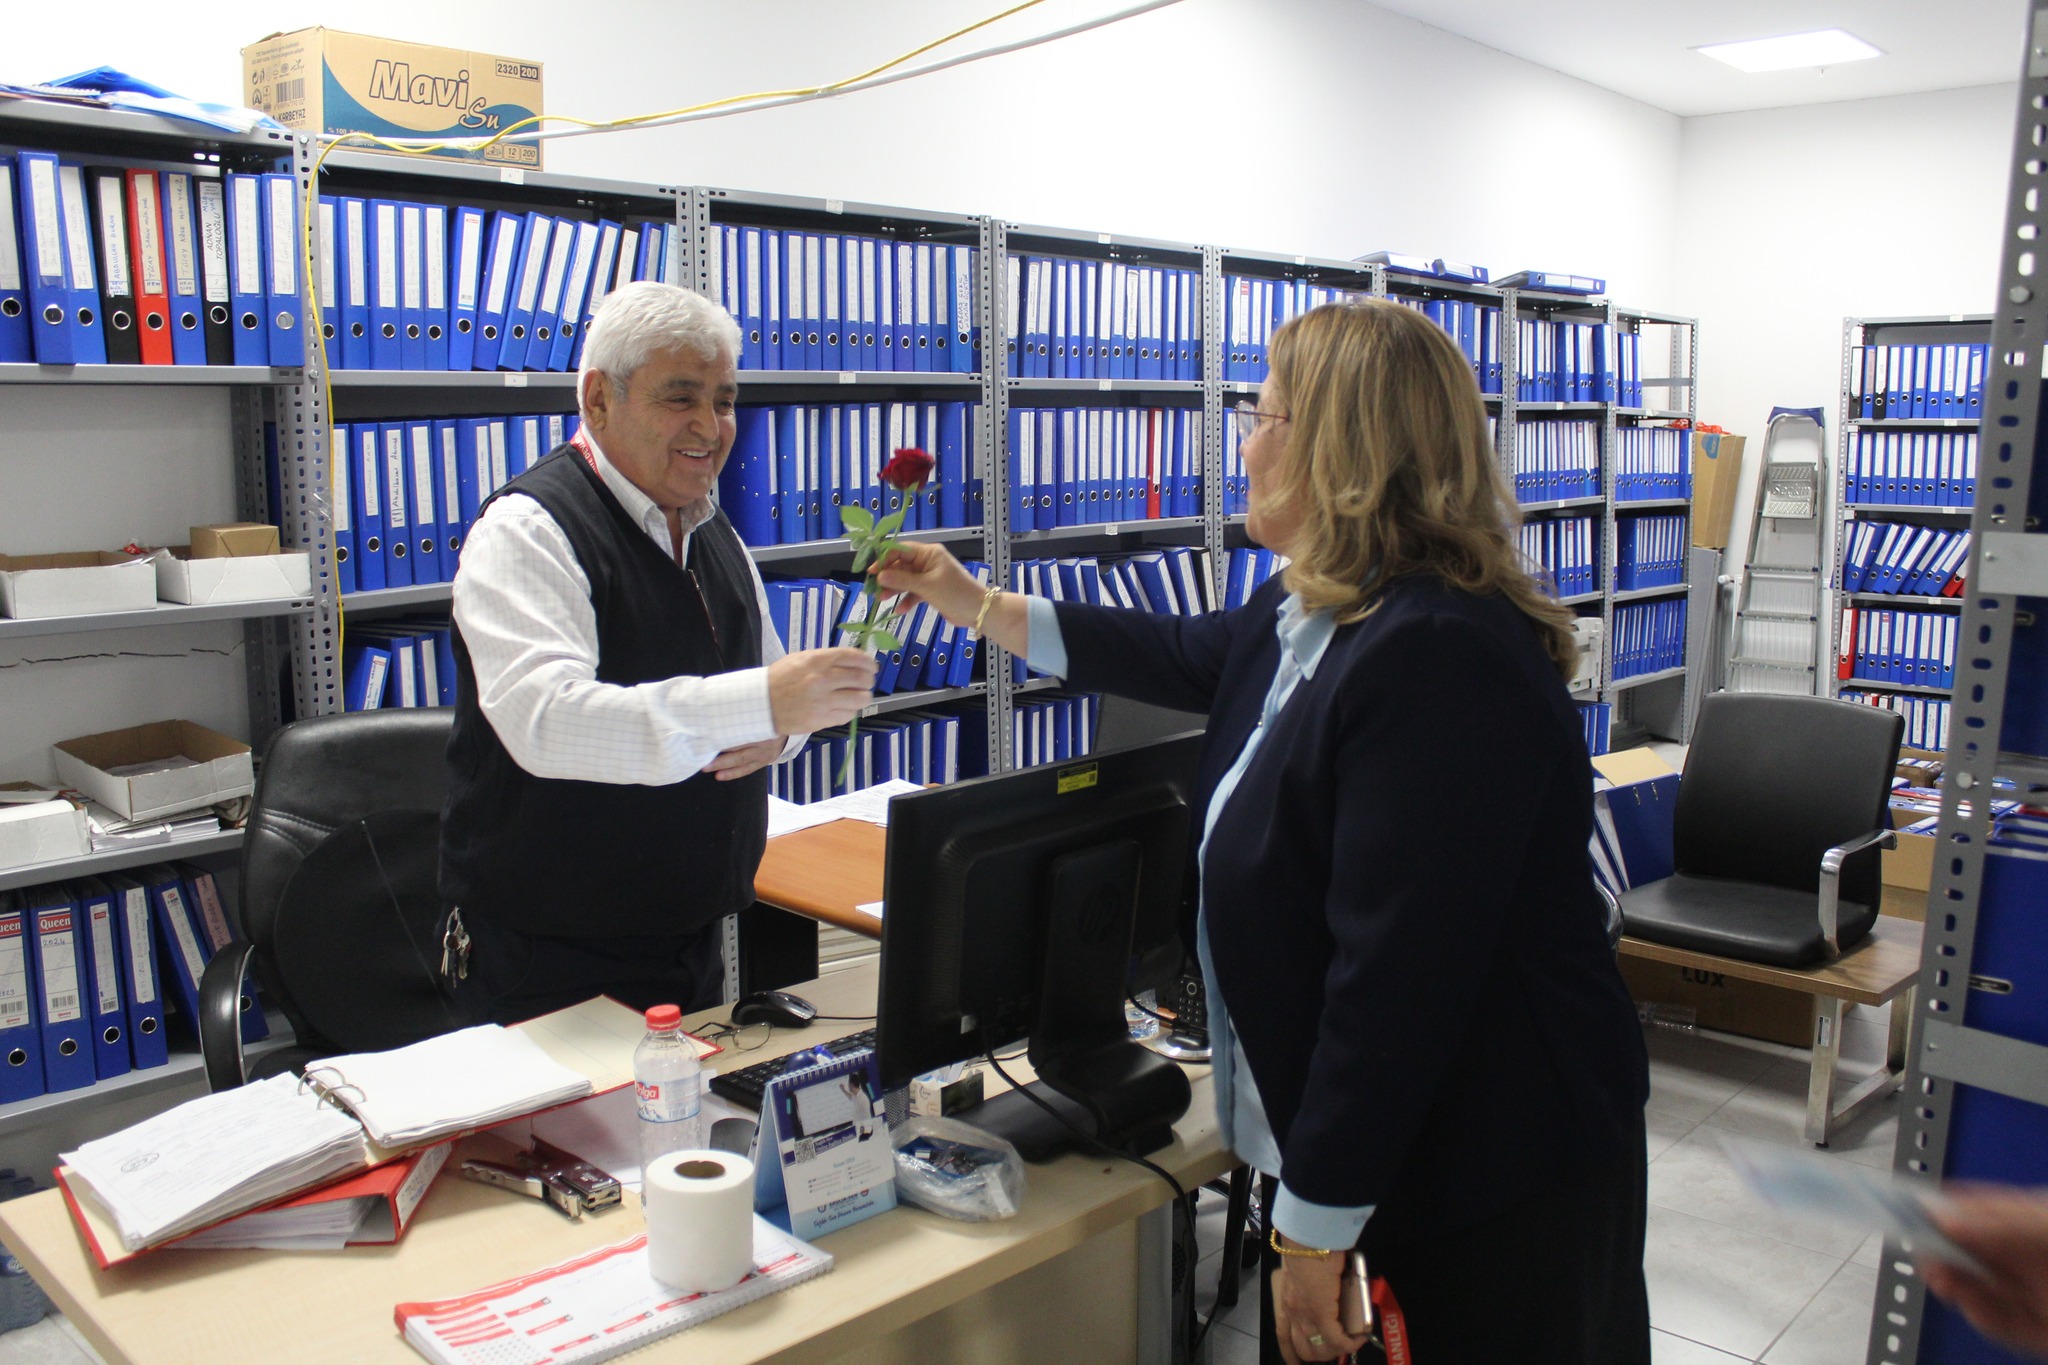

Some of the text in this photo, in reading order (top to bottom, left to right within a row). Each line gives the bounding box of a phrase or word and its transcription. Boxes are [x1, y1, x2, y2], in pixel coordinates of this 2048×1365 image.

[496, 62, 538, 79] 2320 200
[369, 58, 471, 109] Mavi
[522, 149, 537, 158] 200
[205, 222, 214, 251] ADNAN
[213, 212, 224, 261] TOPALOĞLU
[0, 920, 21, 932] ueen
[40, 916, 71, 931] Queen
[1681, 966, 1725, 988] LUX
[1384, 1314, 1405, 1365] ANLIĞI
